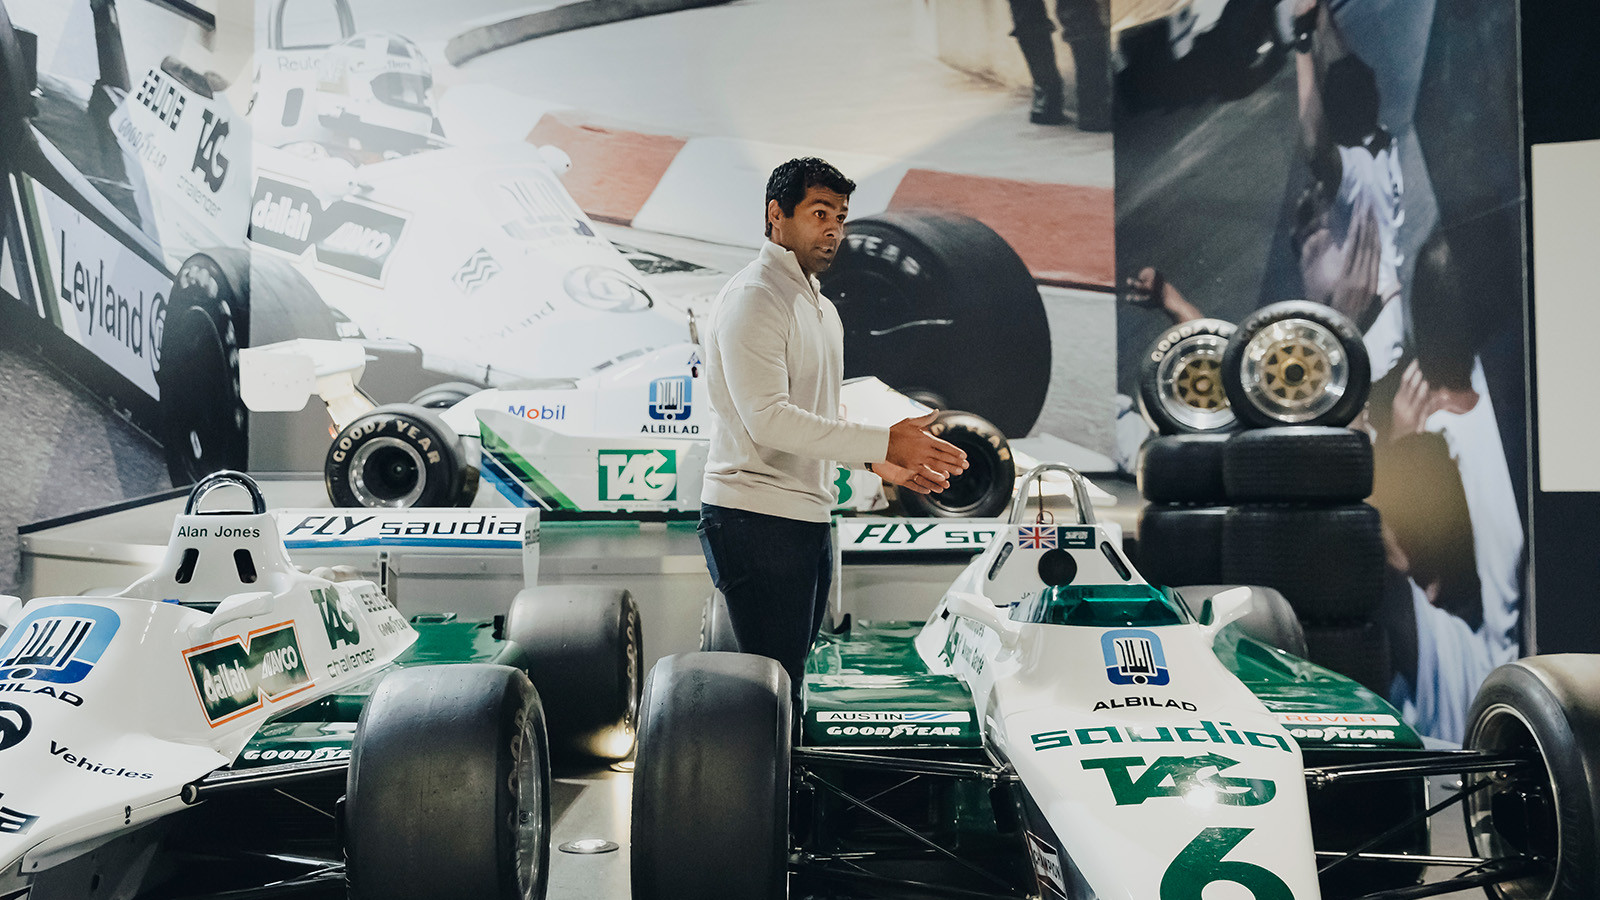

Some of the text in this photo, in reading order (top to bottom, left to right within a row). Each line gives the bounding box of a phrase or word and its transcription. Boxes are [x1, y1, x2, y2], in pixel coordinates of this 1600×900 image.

[252, 191, 313, 242] dallah
[61, 229, 144, 358] Leyland
[508, 405, 565, 421] Mobil
[641, 425, 700, 435] ALBILAD
[599, 448, 678, 501] TAG
[177, 526, 260, 538] Alan Jones
[286, 515, 522, 536] FLY saudia
[854, 523, 938, 544] FLY
[310, 584, 361, 650] TAG
[327, 647, 376, 678] challenger
[203, 660, 251, 703] dallah
[829, 712, 903, 721] AUSTIN
[1092, 696, 1198, 713] ALBILAD
[1285, 715, 1377, 723] ROVER
[826, 723, 961, 739] GOODYEAR
[1030, 720, 1293, 754] saudia
[49, 740, 154, 781] Vehicles
[1080, 751, 1278, 807] TAG
[1159, 826, 1296, 900] 6
